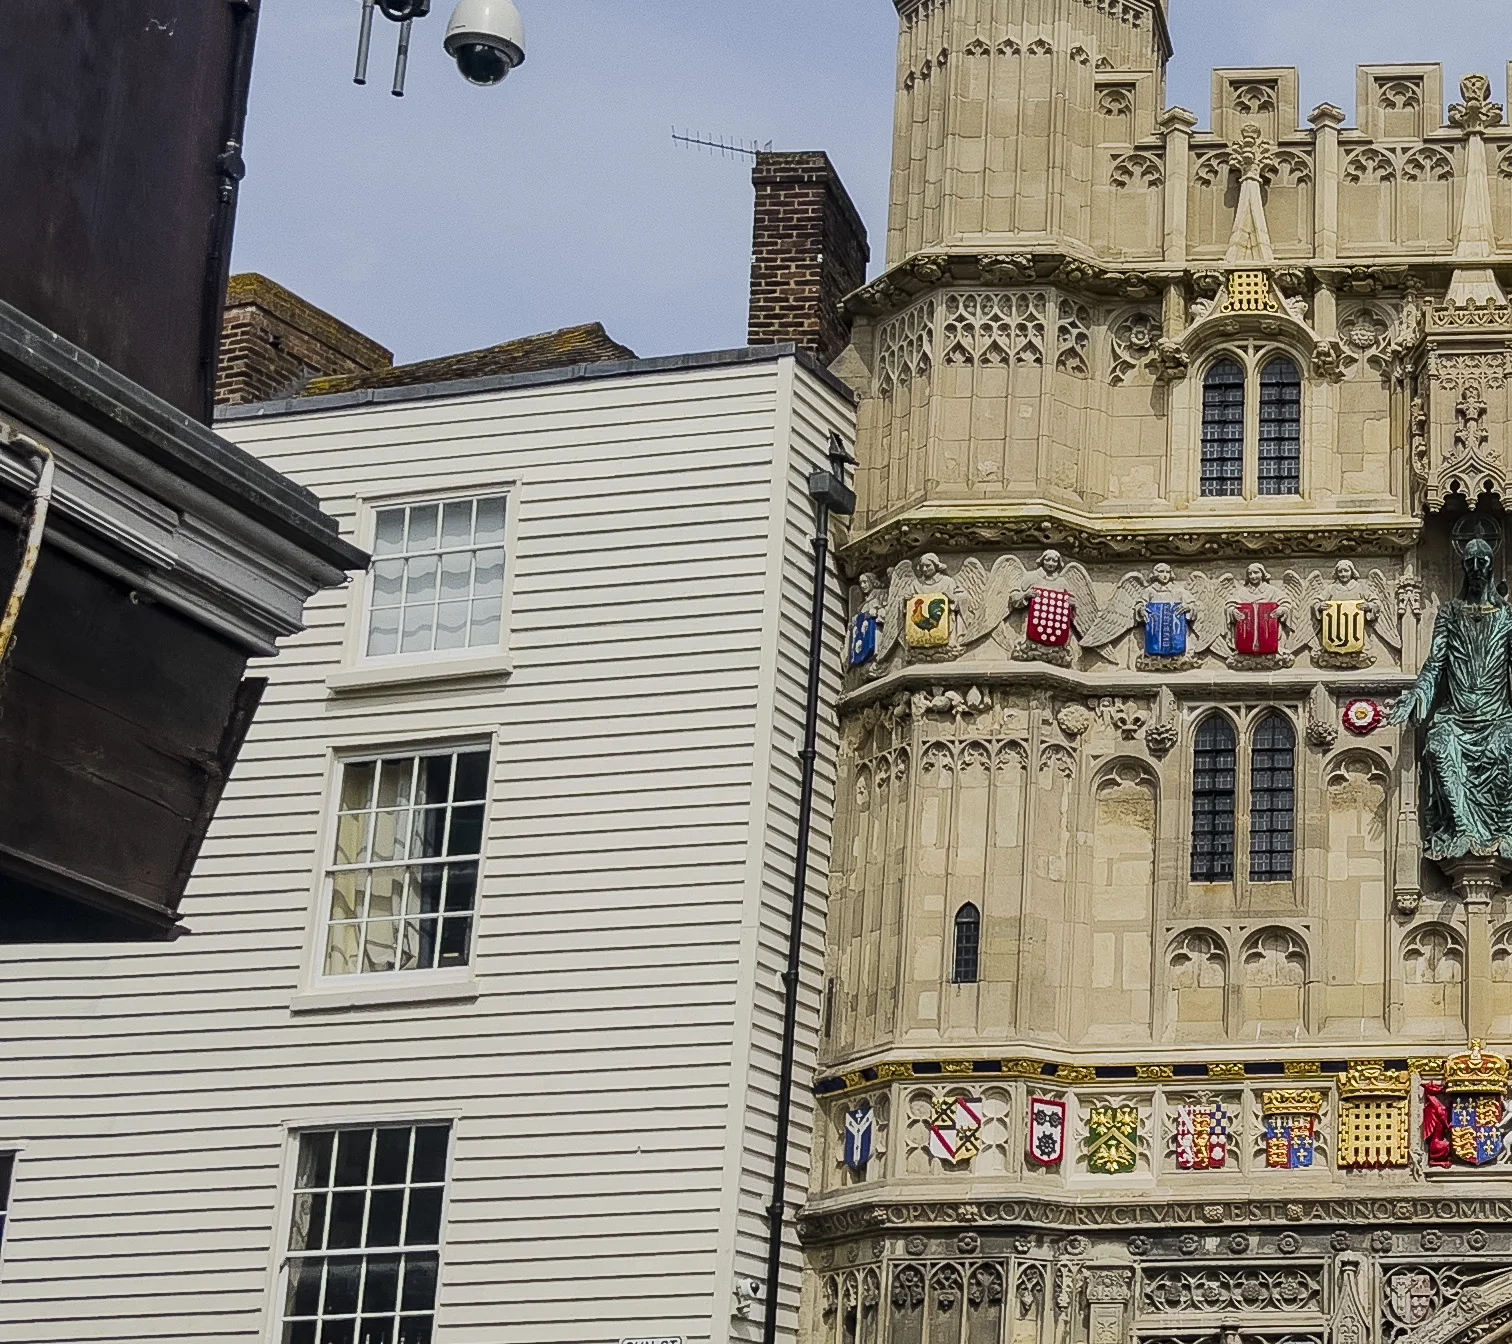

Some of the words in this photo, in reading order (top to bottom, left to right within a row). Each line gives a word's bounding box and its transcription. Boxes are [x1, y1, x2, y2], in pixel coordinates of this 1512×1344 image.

[887, 1205, 957, 1223] OPVS
[980, 1202, 1197, 1226] CONSTRVCTVM
[1231, 1203, 1282, 1222] EST
[1309, 1200, 1392, 1220] ANNO
